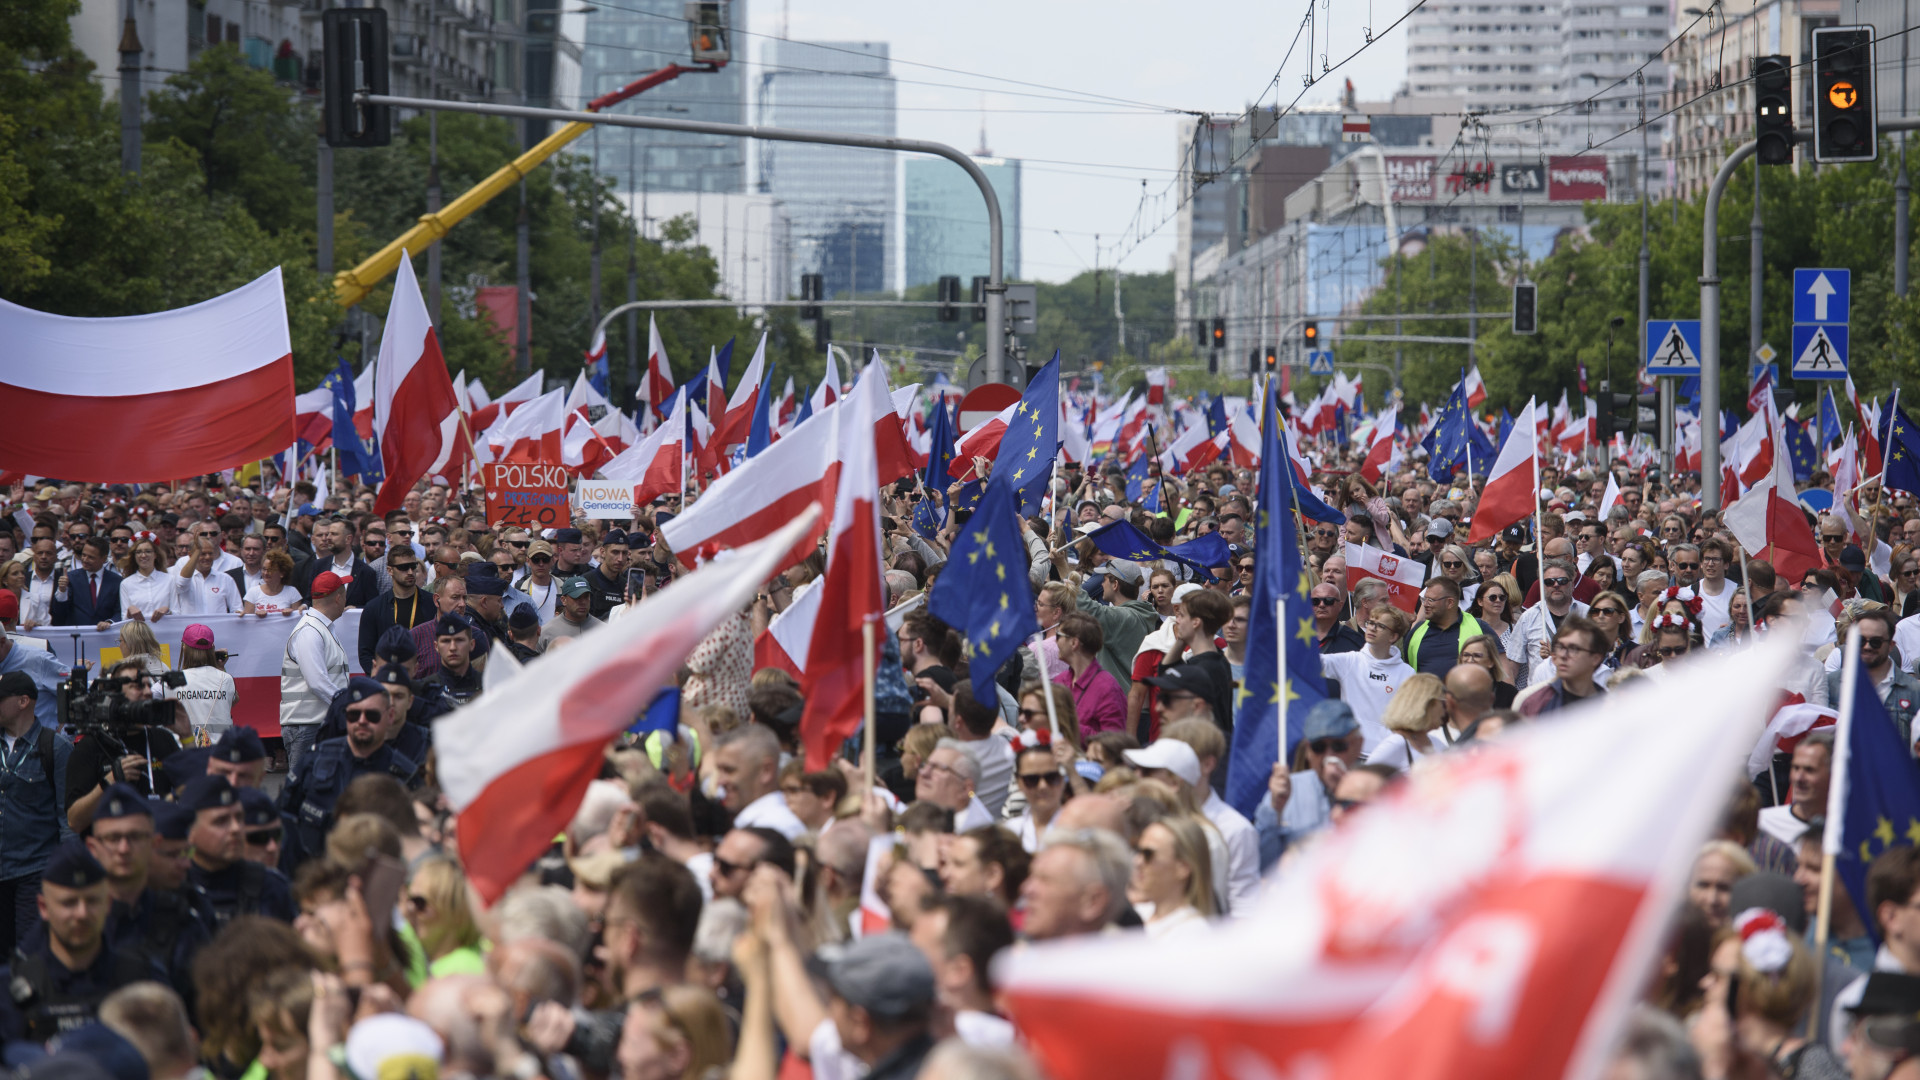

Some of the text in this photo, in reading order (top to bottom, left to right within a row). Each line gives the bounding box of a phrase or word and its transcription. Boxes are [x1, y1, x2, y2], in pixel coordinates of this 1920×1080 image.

[1387, 160, 1433, 181] Half
[1443, 161, 1494, 194] HM
[495, 465, 567, 489] POLSKO
[504, 491, 567, 505] PRZEGONIMY
[582, 488, 631, 501] NOWA
[497, 505, 557, 525] ZŁO
[583, 501, 631, 512] Generacja
[176, 690, 227, 701] ORGANIZATOR
